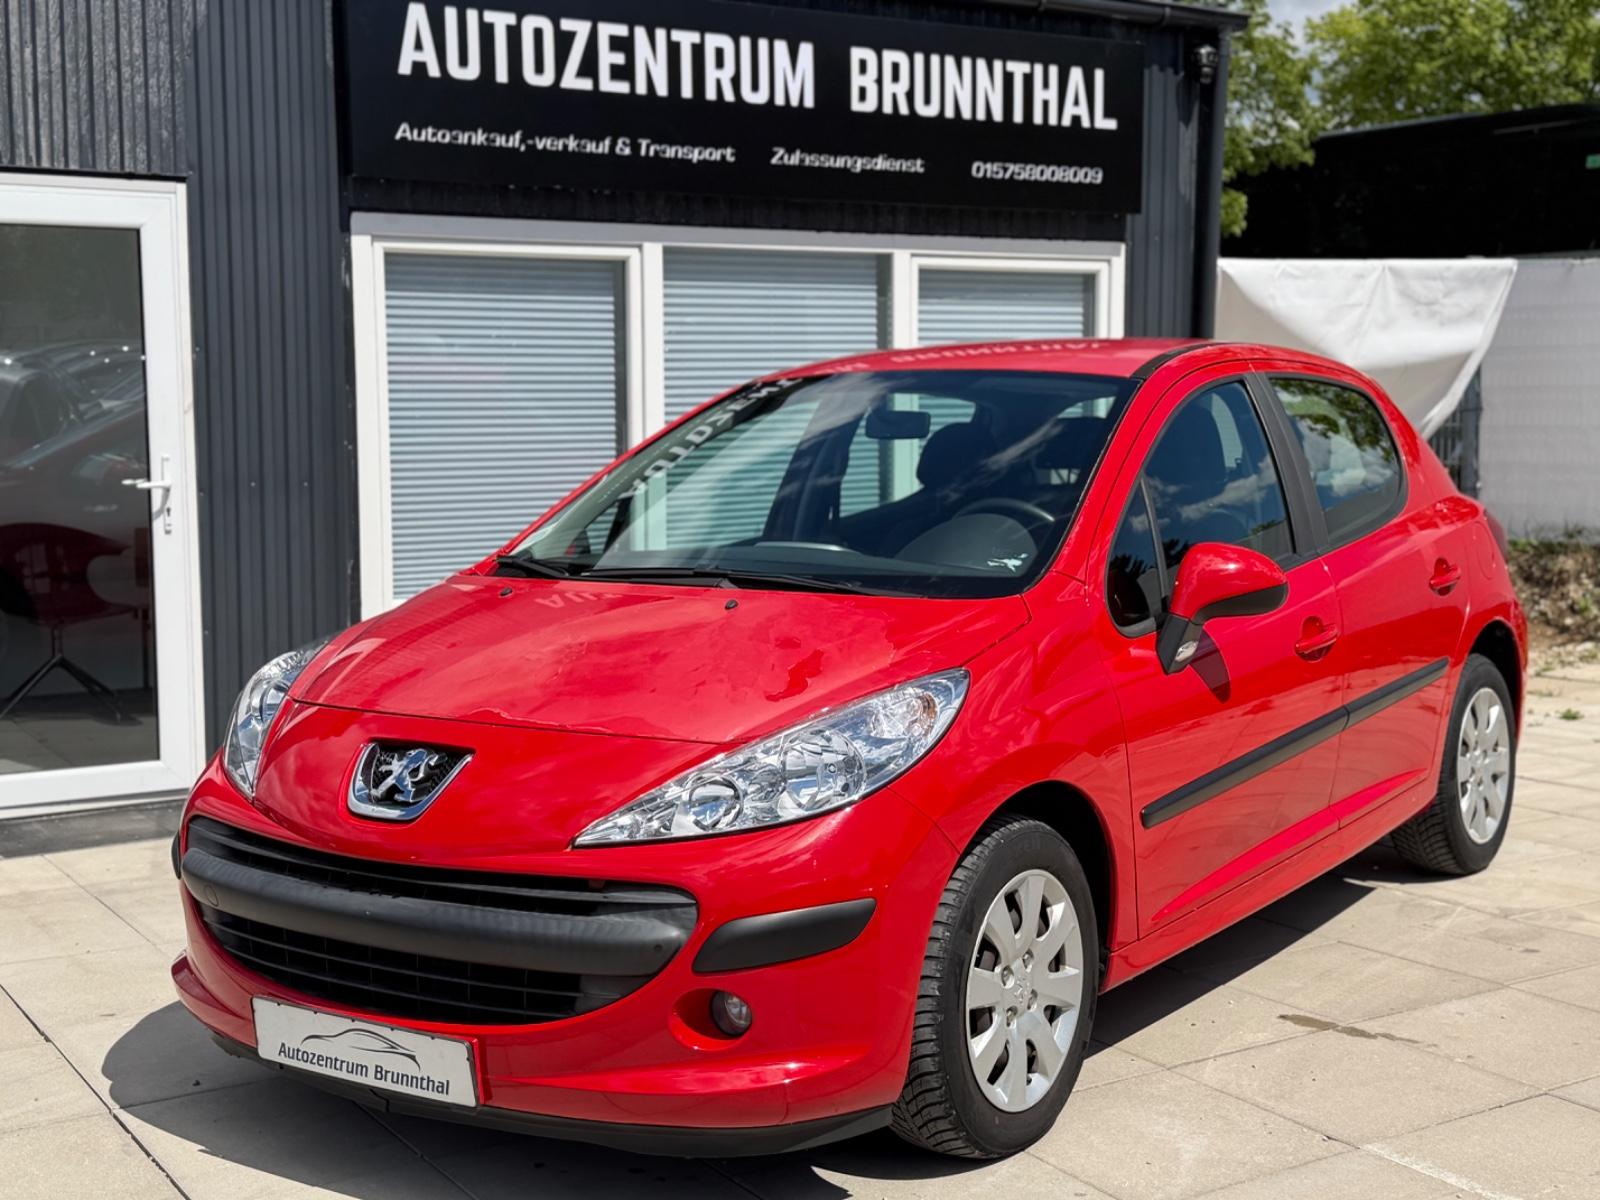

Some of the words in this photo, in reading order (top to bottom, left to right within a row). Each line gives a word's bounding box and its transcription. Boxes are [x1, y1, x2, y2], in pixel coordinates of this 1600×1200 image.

[398, 2, 815, 108] AUTOZENTRUM
[850, 46, 1118, 130] BRUNNTHAL
[615, 137, 632, 155] &
[638, 139, 736, 163] Transport
[278, 1042, 369, 1078] Autozentrum
[374, 1065, 450, 1096] Brunnthal
